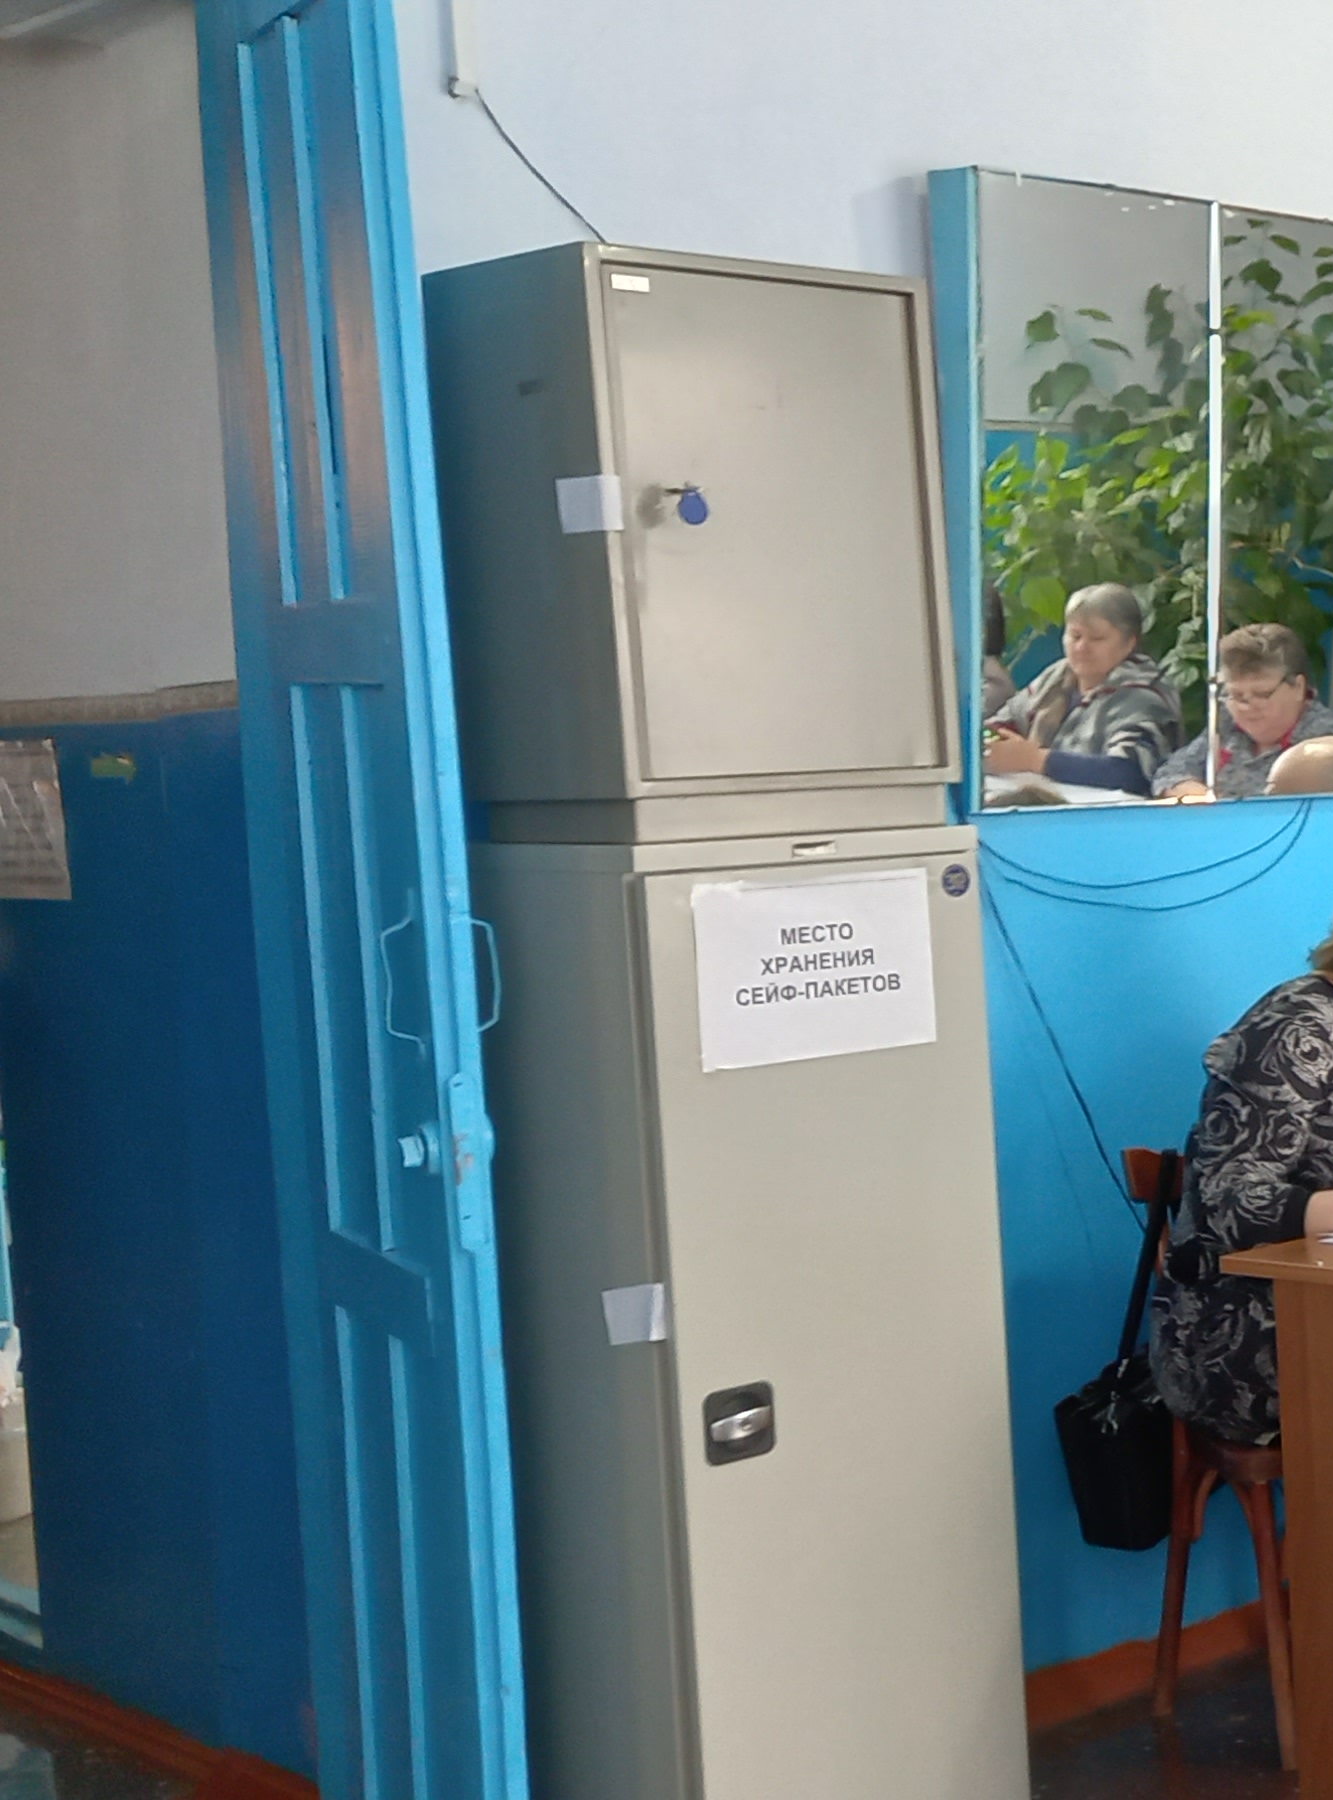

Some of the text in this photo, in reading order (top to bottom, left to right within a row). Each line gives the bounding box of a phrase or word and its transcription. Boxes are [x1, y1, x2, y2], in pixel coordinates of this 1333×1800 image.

[780, 922, 854, 946] МЕСТО
[760, 948, 875, 976] ХРАНЕНИЯ
[735, 973, 901, 1007] СЕЙФ-ПАКЕТОВ
